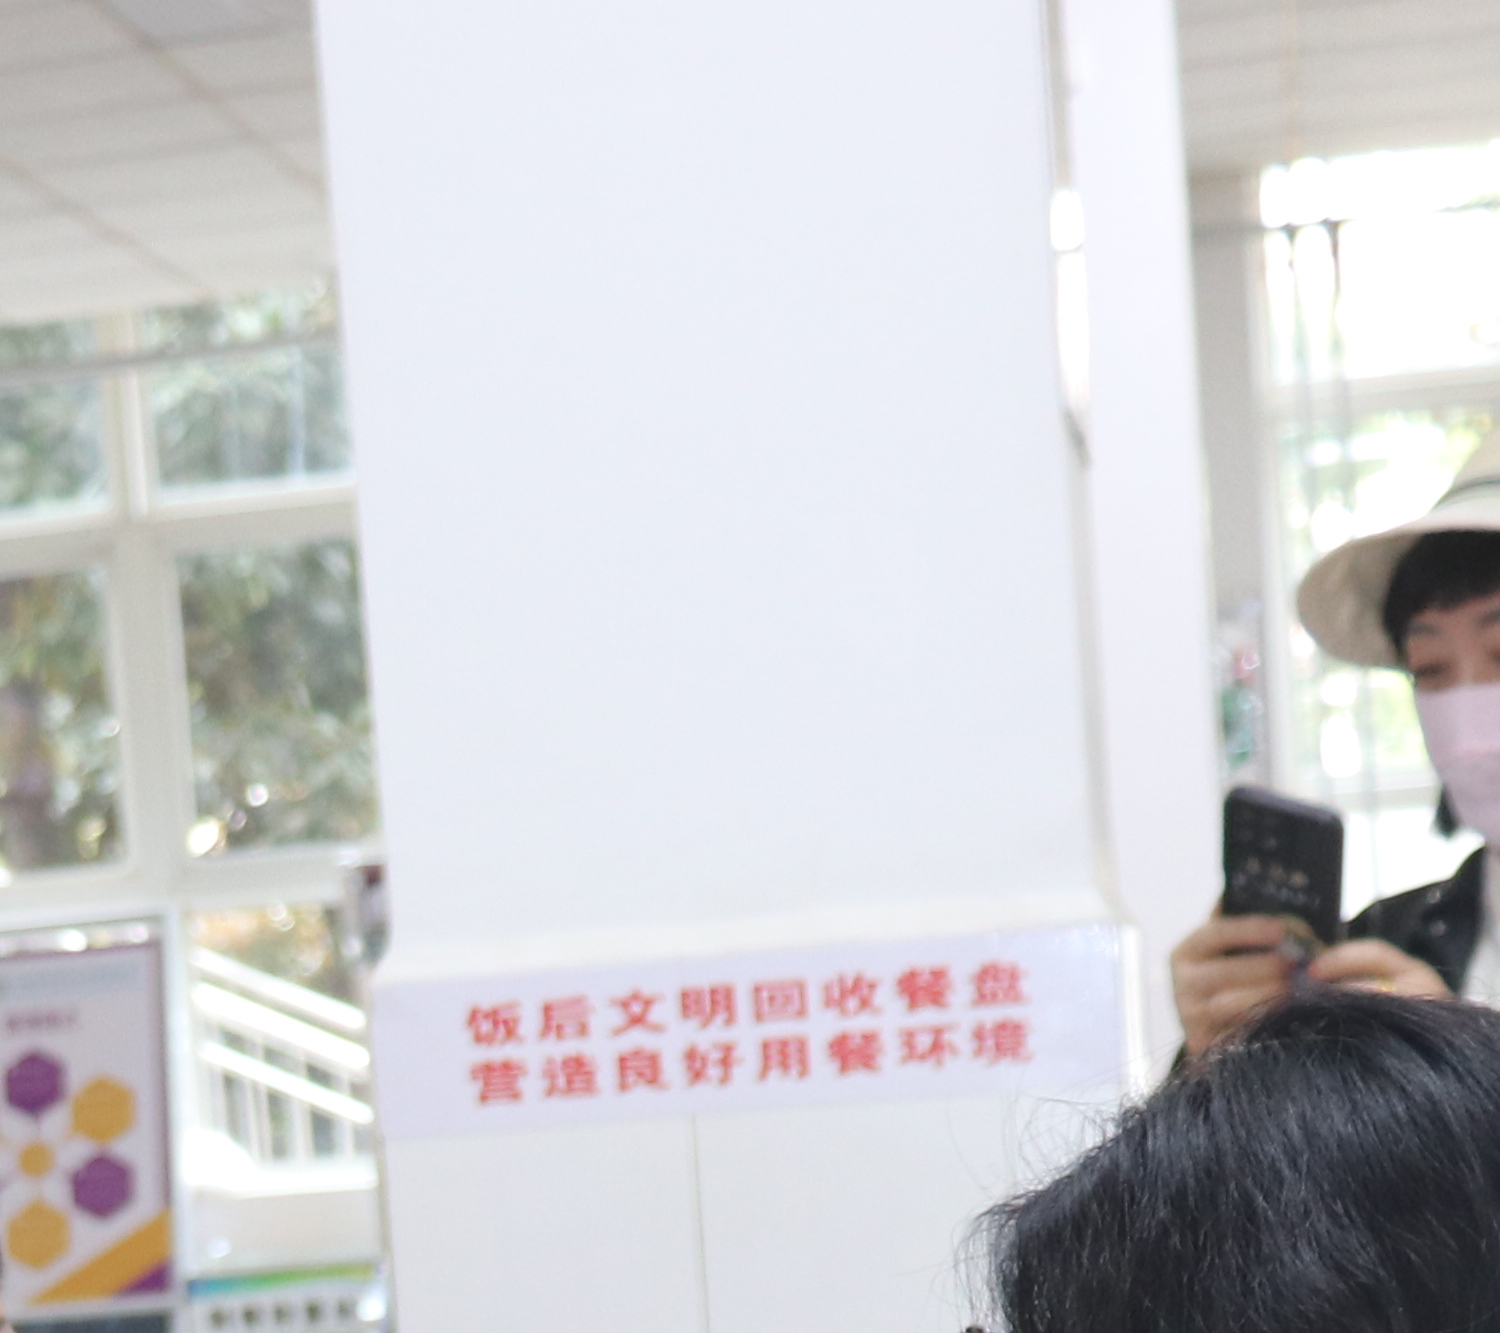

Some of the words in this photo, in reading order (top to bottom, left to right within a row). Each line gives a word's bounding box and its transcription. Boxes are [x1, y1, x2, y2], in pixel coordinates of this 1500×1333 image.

[467, 961, 1029, 1046] 饭后文明回收餐盘
[470, 1018, 1031, 1104] 营造良好用餐环境
